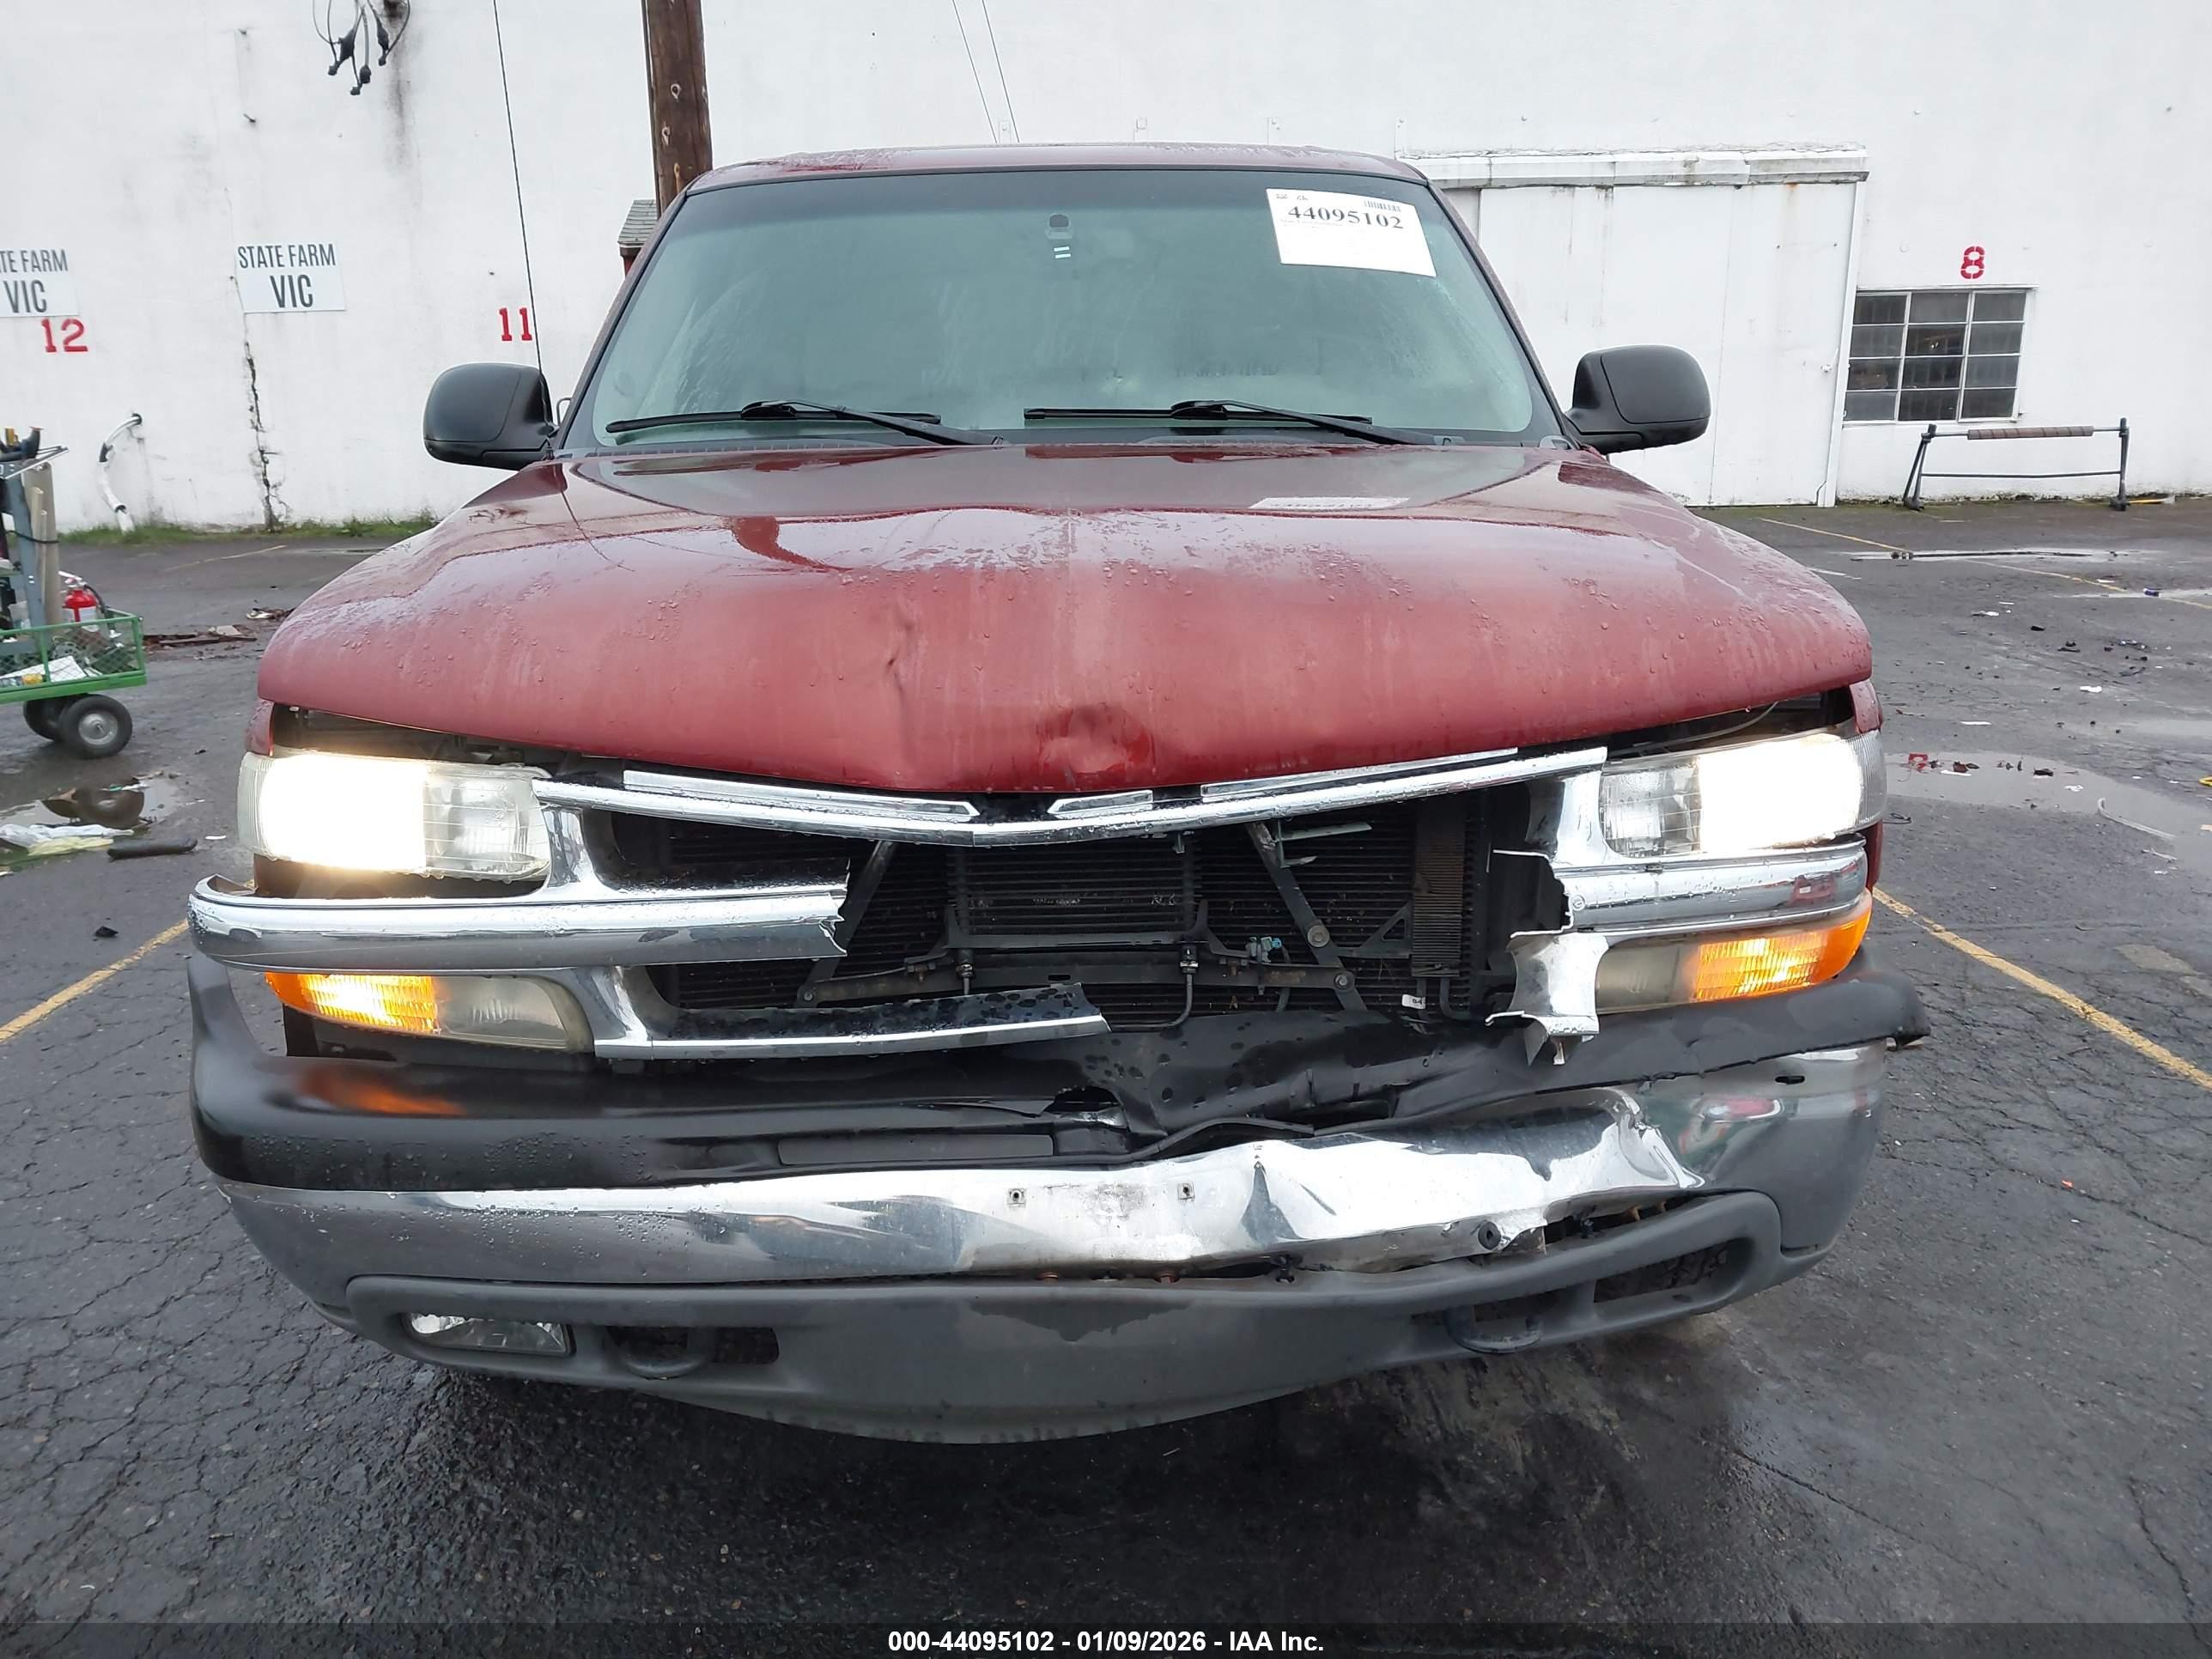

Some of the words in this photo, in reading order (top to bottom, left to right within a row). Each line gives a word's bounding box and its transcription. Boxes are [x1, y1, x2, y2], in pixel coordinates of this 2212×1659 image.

[1288, 205, 1403, 229] 44095102
[0, 250, 18, 273] TE
[21, 249, 69, 273] FARM
[238, 246, 285, 269] STATE
[289, 243, 337, 268] FARM
[1960, 246, 1985, 280] 8
[3, 279, 47, 313] VIC
[270, 274, 313, 308] VIC
[41, 319, 88, 353] 12
[499, 307, 532, 342] 11
